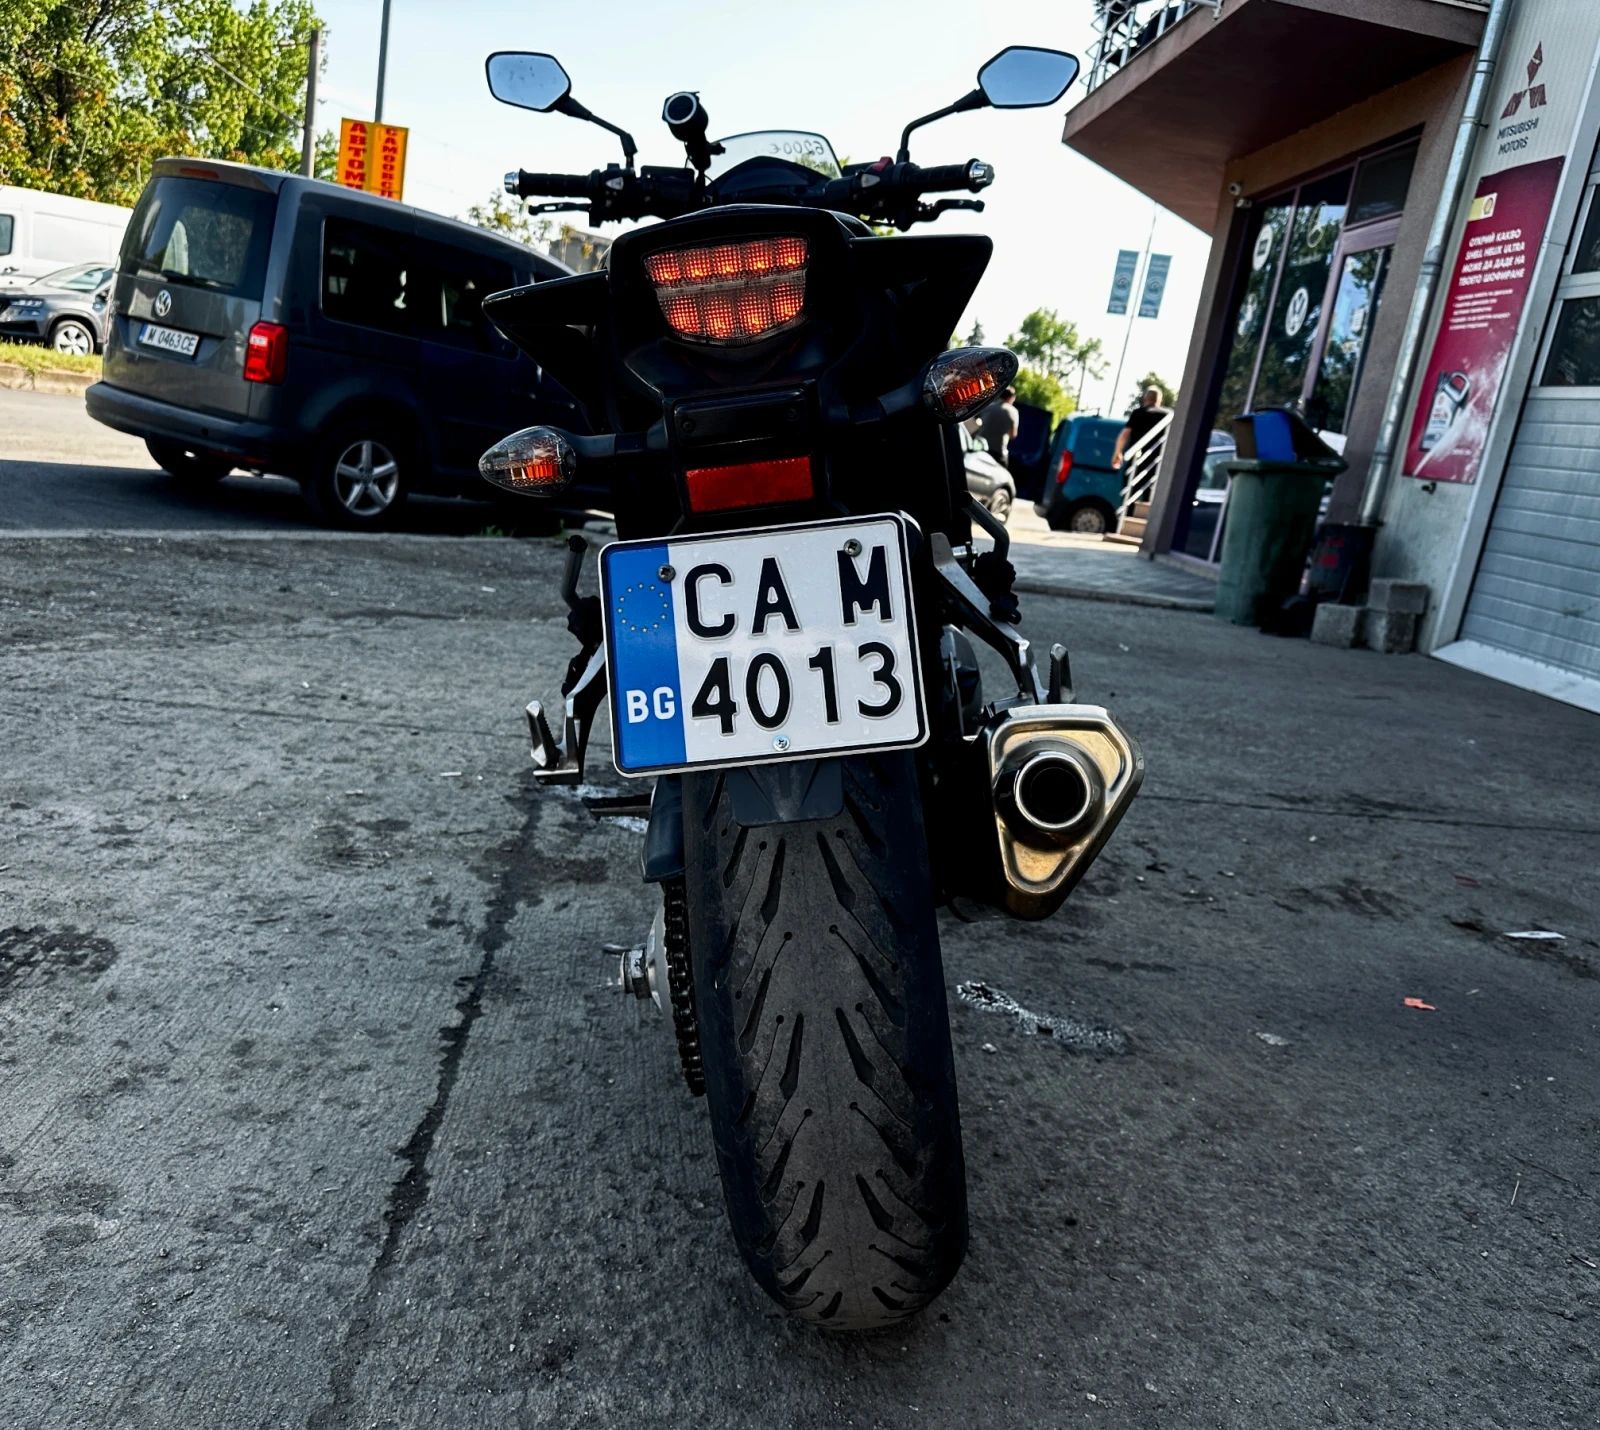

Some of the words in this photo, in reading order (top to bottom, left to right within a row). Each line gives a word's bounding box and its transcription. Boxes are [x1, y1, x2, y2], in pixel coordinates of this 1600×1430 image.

[1497, 117, 1540, 140] MITSUBISHI
[1498, 136, 1529, 155] MOTORS
[684, 557, 801, 639] CA
[836, 545, 893, 626] M
[626, 686, 675, 724] BG
[691, 641, 903, 736] 4013
